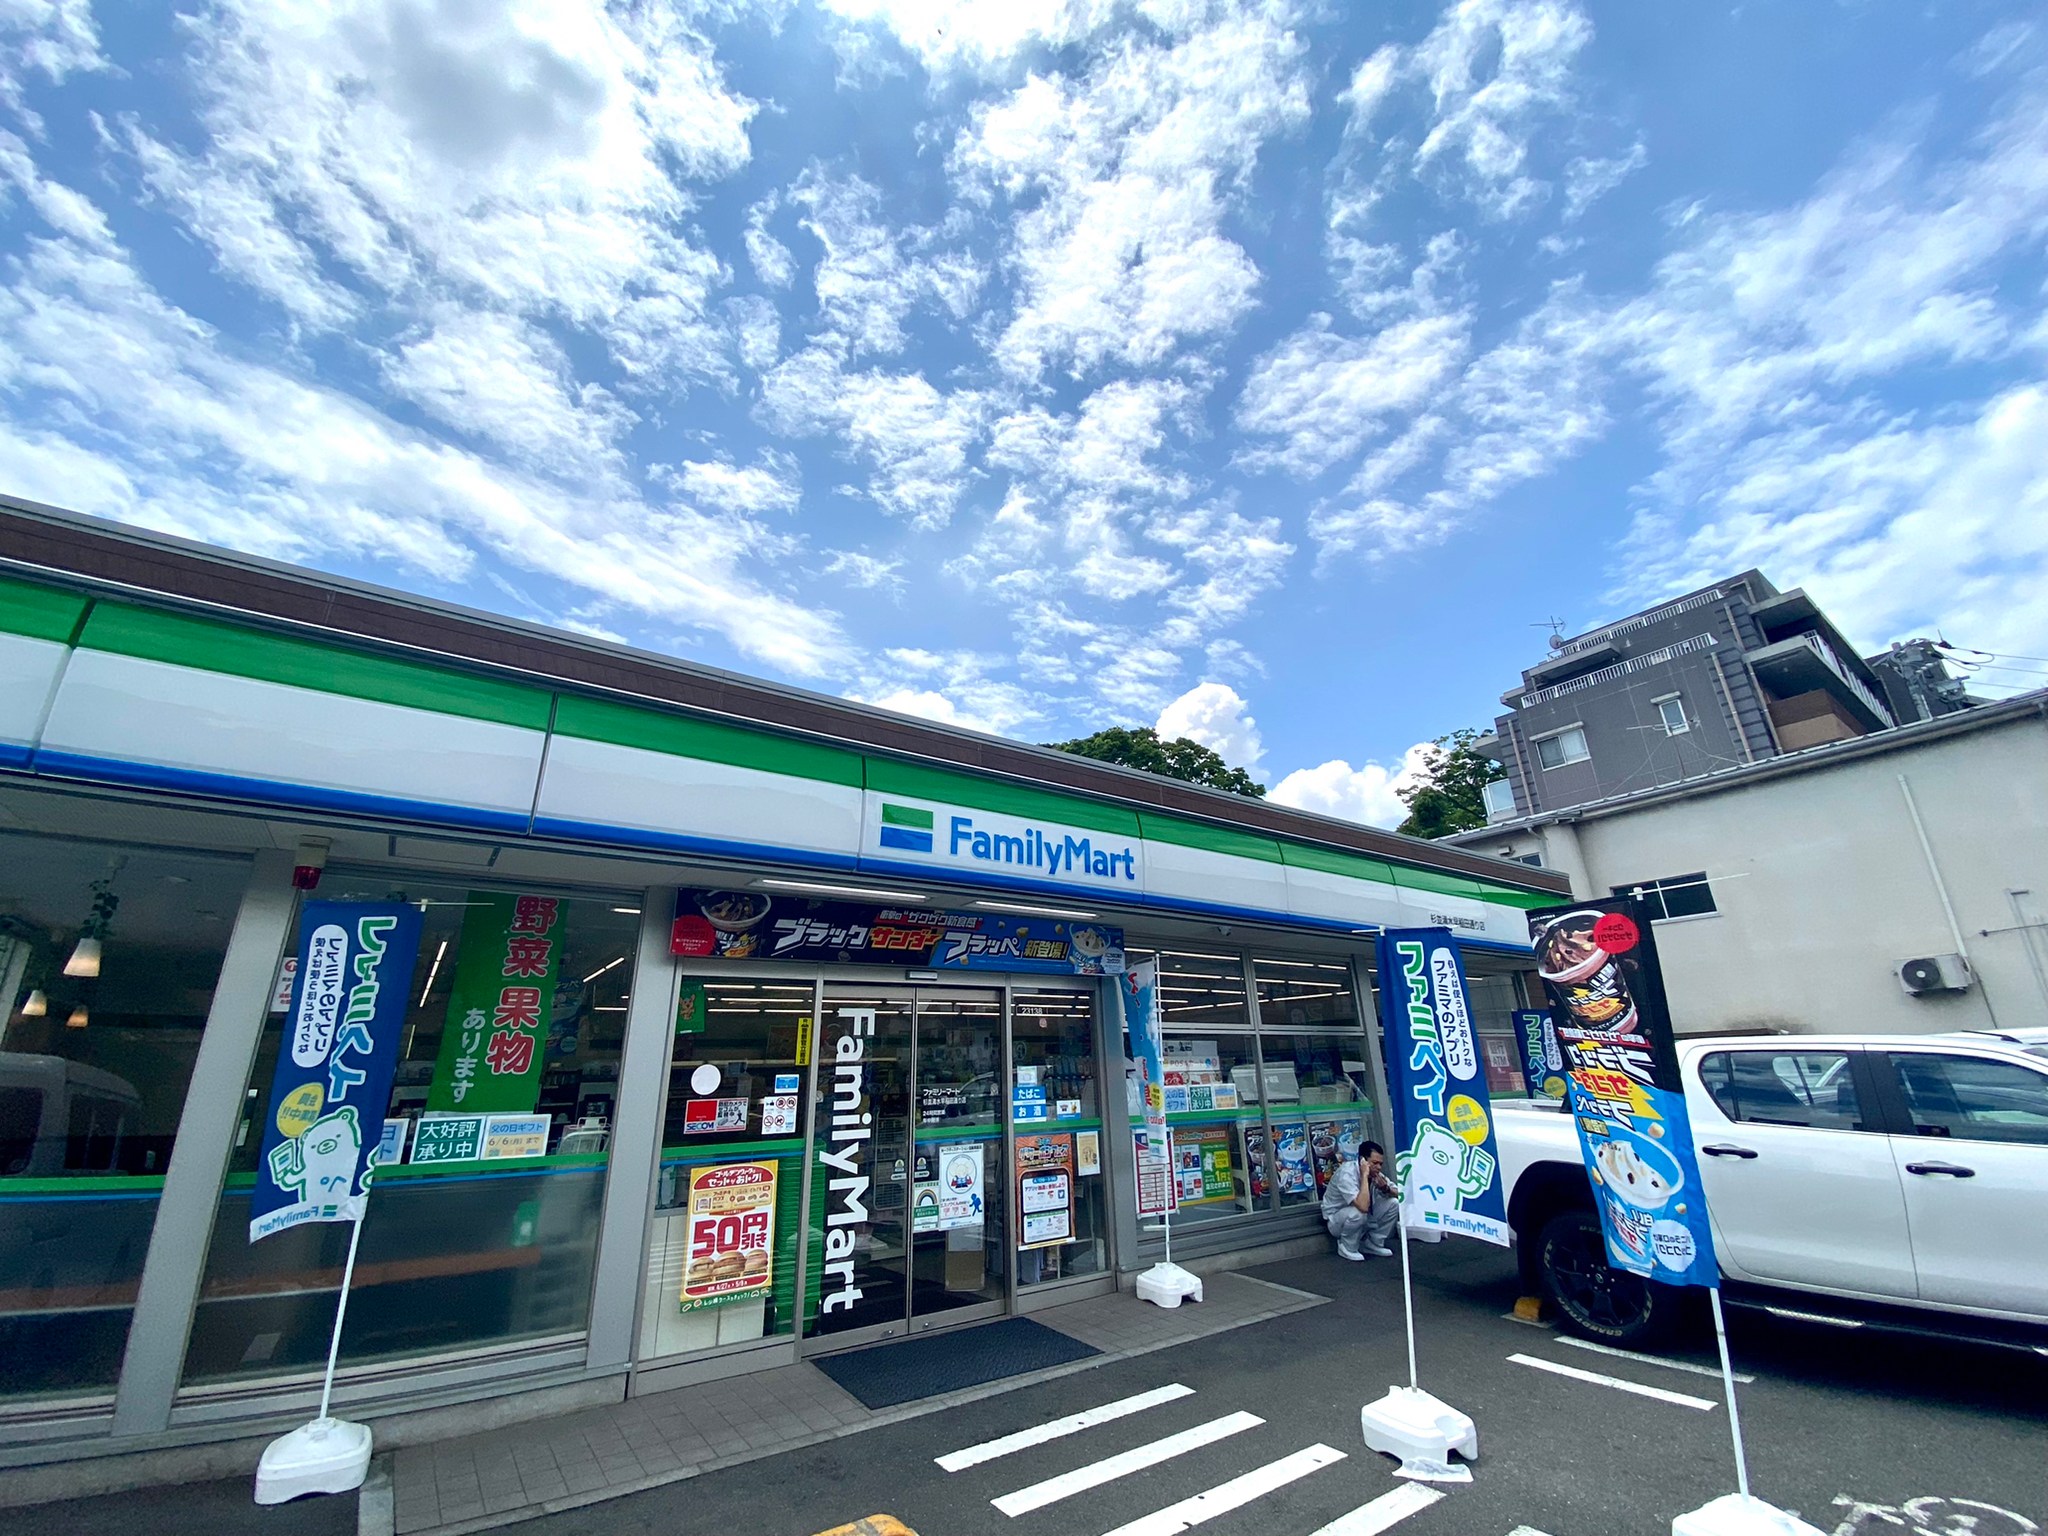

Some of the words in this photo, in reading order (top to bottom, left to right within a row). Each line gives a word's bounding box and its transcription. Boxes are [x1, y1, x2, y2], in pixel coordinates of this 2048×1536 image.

[950, 816, 1135, 880] FamilyMart
[772, 918, 869, 953] ブラック
[870, 926, 942, 951] サンダー
[943, 931, 1022, 964] フラッペ
[485, 895, 559, 1075] 野菜果物
[1021, 1007, 1043, 1015] 23138
[1396, 941, 1447, 1116] ファミペイ
[1434, 960, 1460, 1066] ファミマのアプリ
[451, 1008, 486, 1103] あります
[1523, 1014, 1546, 1087] ファミペイ
[1018, 1088, 1041, 1100] たばこ
[1018, 1105, 1042, 1117] お酒
[421, 1121, 477, 1140] 大好評
[490, 1122, 543, 1133] 父の日ギフト
[687, 1122, 715, 1131] SECOM
[418, 1141, 473, 1161] 承り中
[819, 1008, 875, 1314] FamilyMart
[1443, 1214, 1499, 1238] FamilyMart
